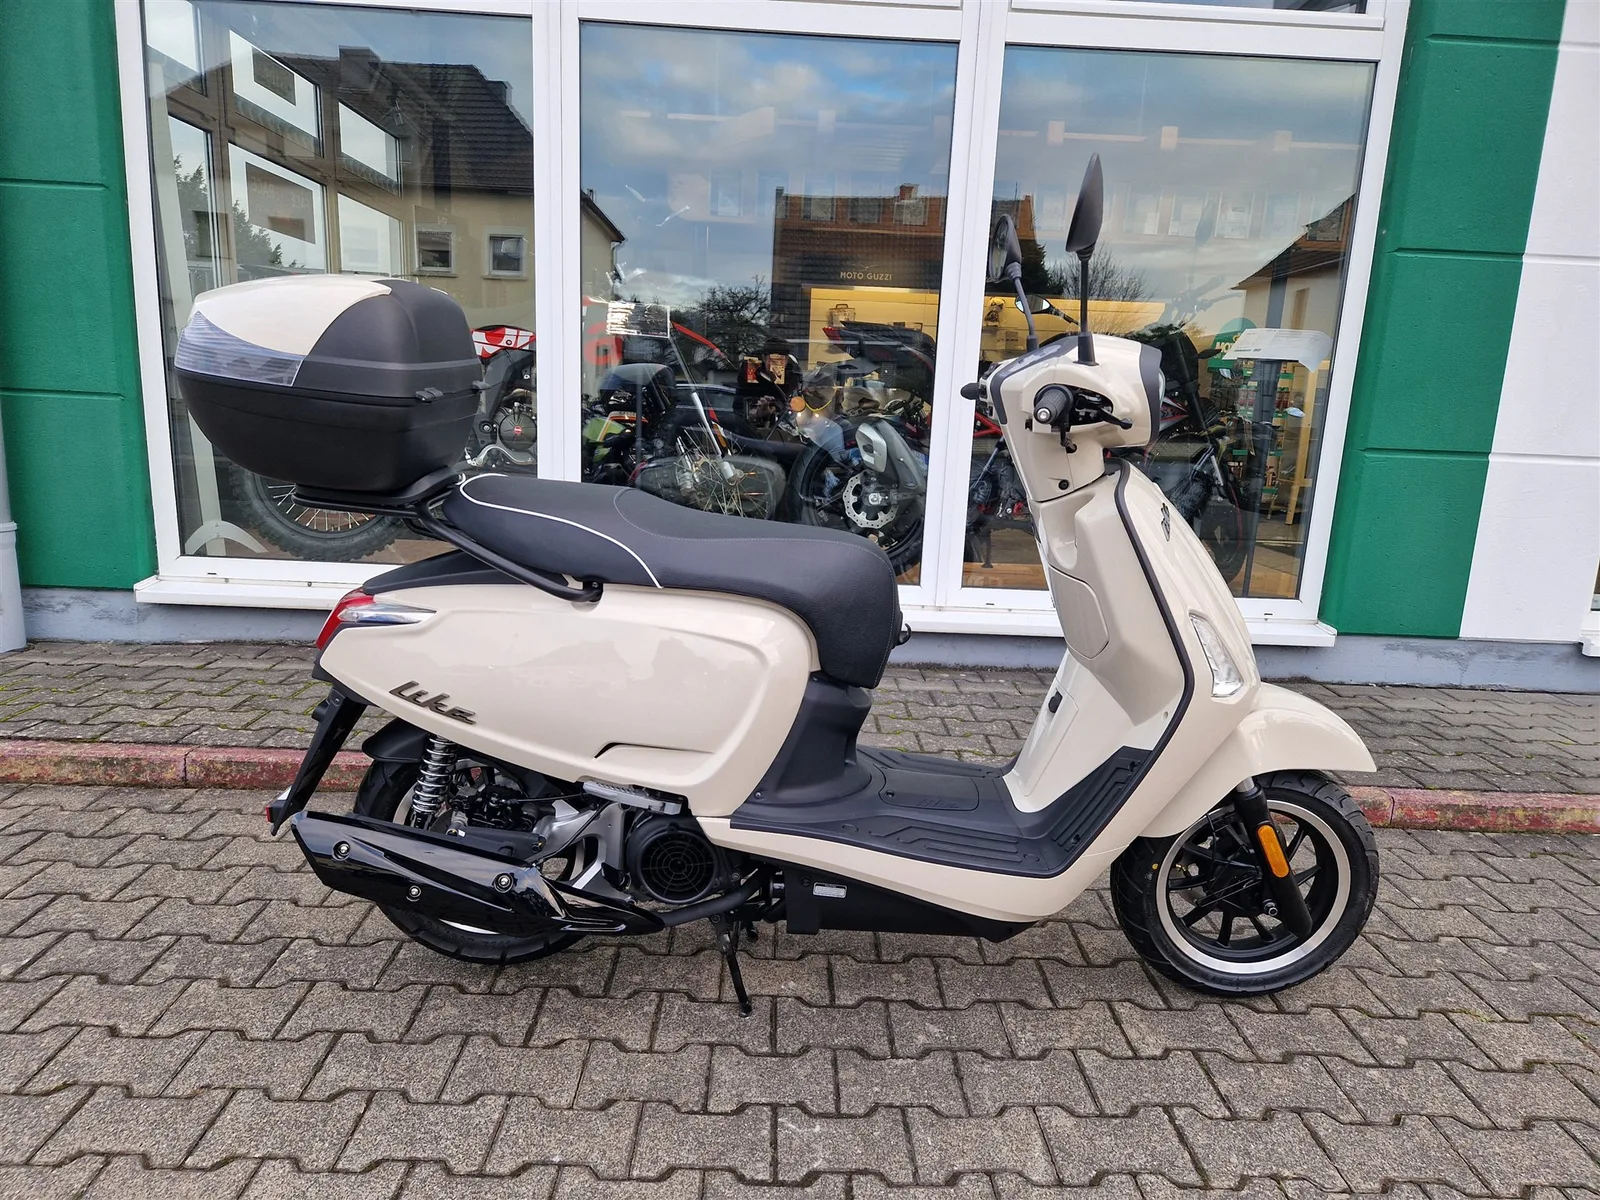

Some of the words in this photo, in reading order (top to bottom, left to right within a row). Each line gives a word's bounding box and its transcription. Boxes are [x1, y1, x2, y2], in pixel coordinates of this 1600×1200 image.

[839, 271, 864, 280] MOTO
[866, 272, 892, 281] GUZZI
[388, 680, 477, 725] Like
